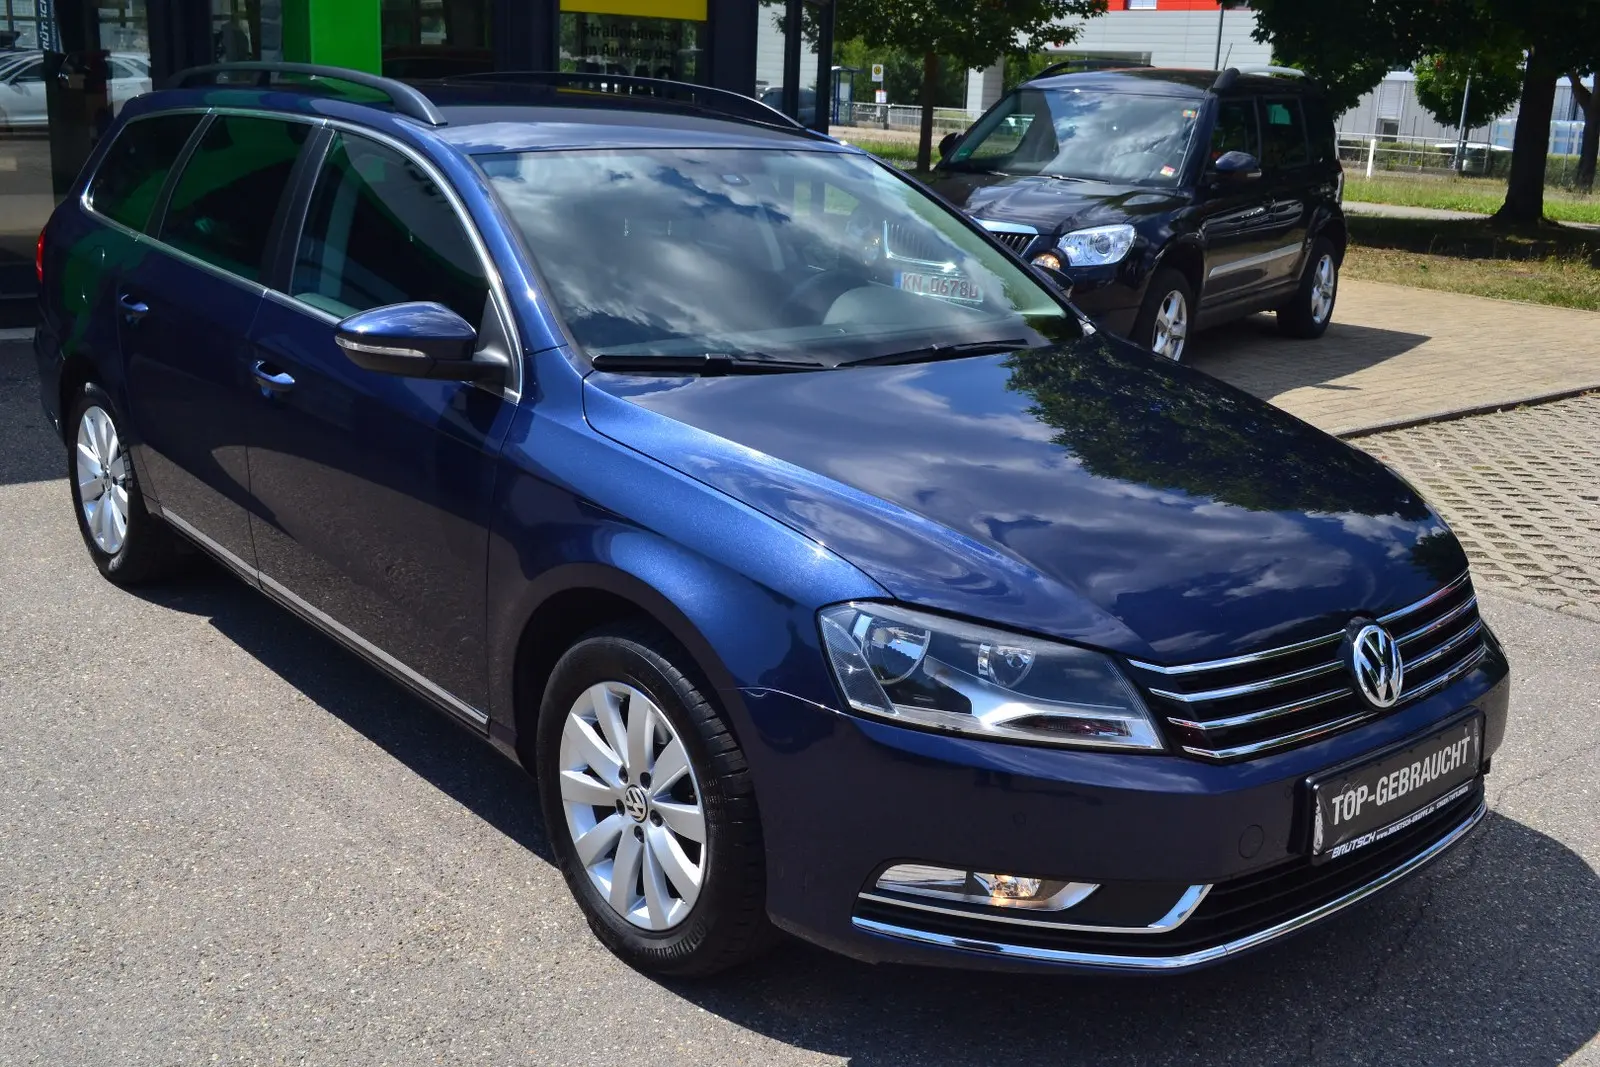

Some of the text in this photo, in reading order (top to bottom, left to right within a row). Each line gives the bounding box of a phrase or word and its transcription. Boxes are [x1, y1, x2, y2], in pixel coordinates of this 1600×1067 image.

[581, 21, 679, 42] Straßendienst
[601, 43, 652, 61] Auftrag
[654, 46, 678, 59] des
[903, 274, 922, 293] KN
[1331, 735, 1471, 826] TOP-GEBRAUCHT
